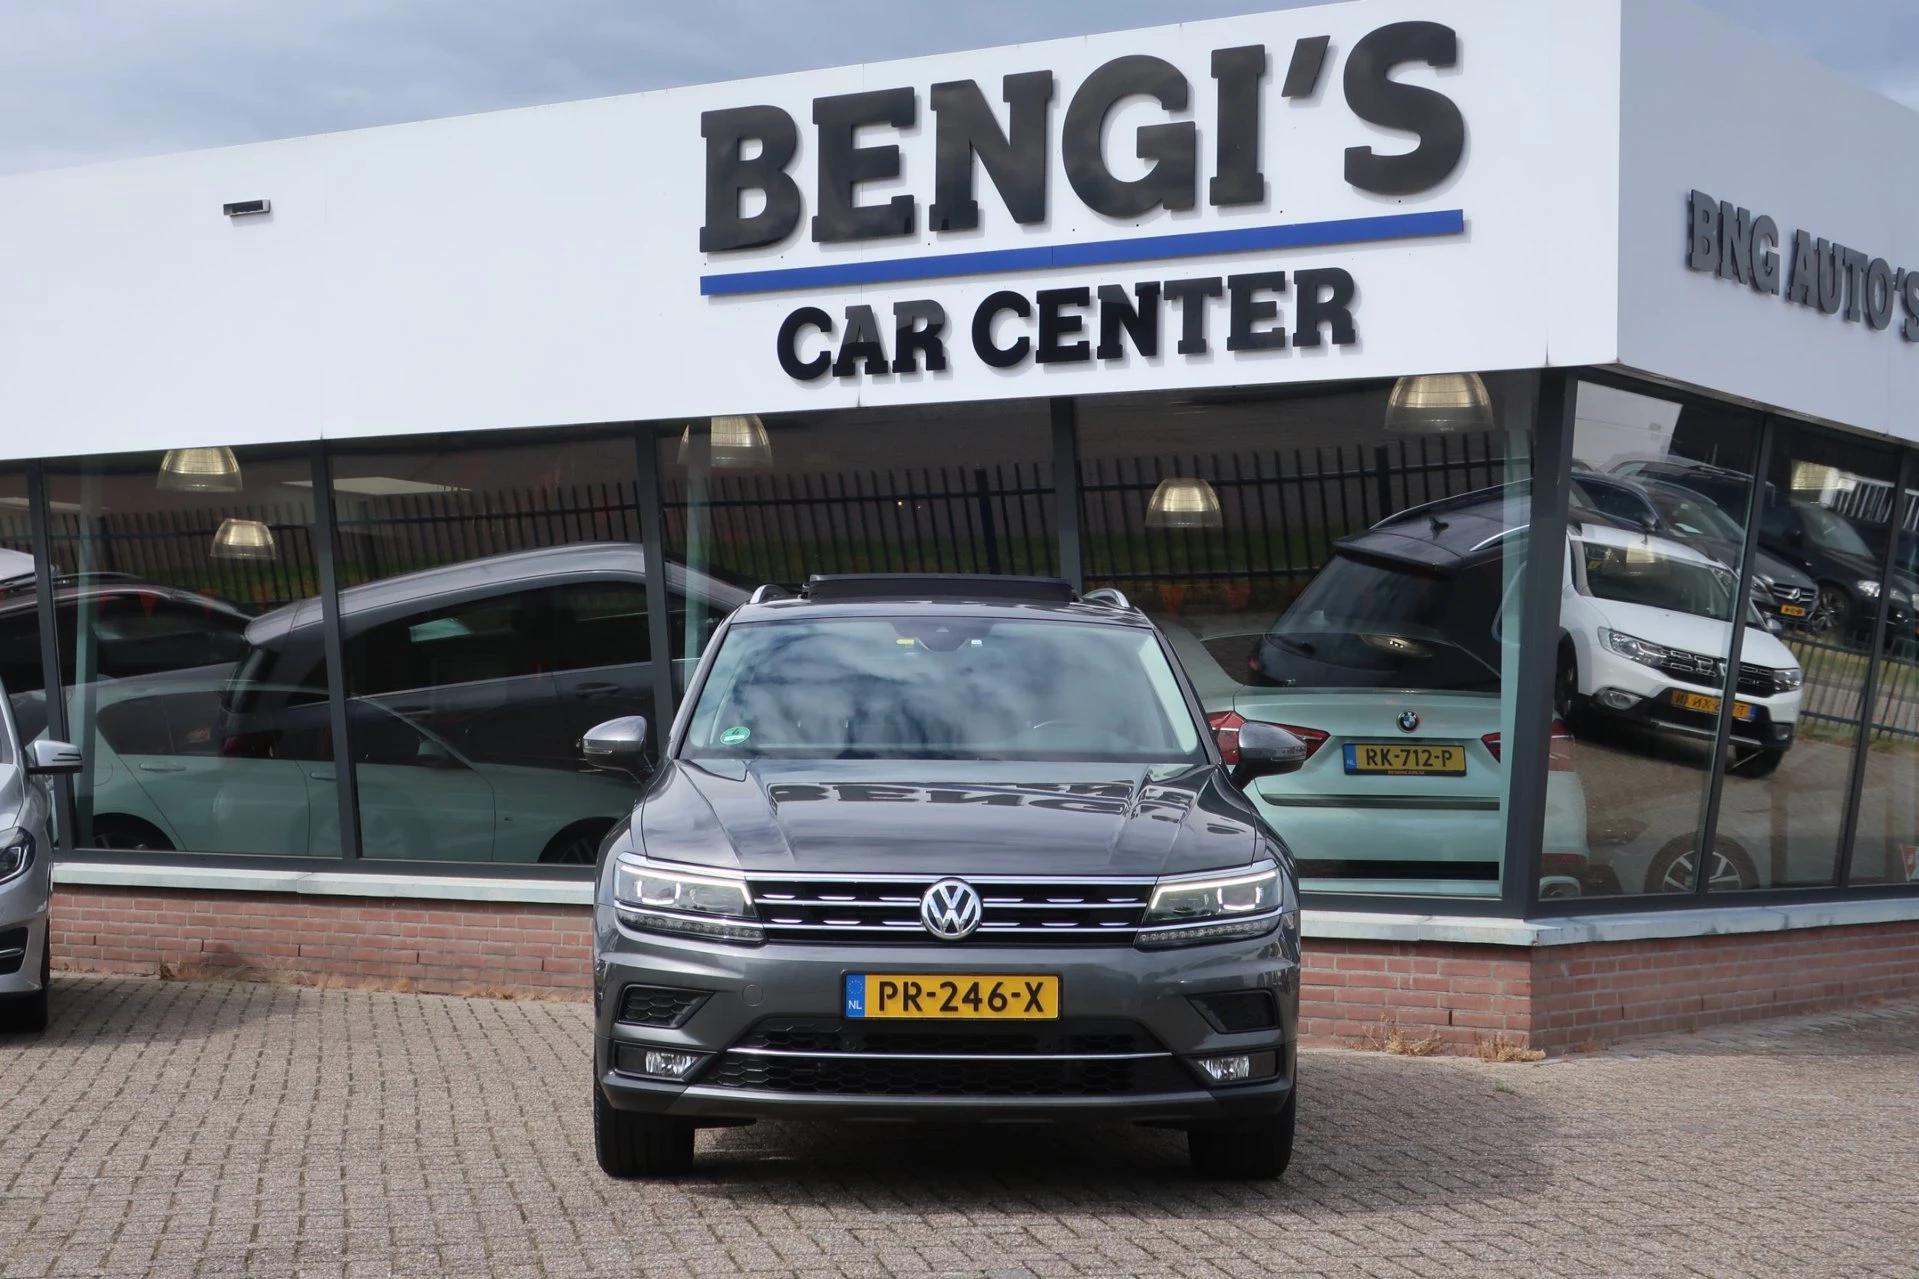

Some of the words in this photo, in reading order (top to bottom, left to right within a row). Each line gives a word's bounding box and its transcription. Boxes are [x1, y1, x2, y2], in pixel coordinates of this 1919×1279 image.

[700, 20, 1465, 254] BENGI'S
[1689, 188, 1781, 296] BNG
[776, 298, 947, 381] CAR
[971, 267, 1356, 369] CENTER
[1365, 747, 1453, 768] RK-712-P
[848, 1000, 862, 1010] NL
[878, 980, 1045, 1013] PR-246-X
